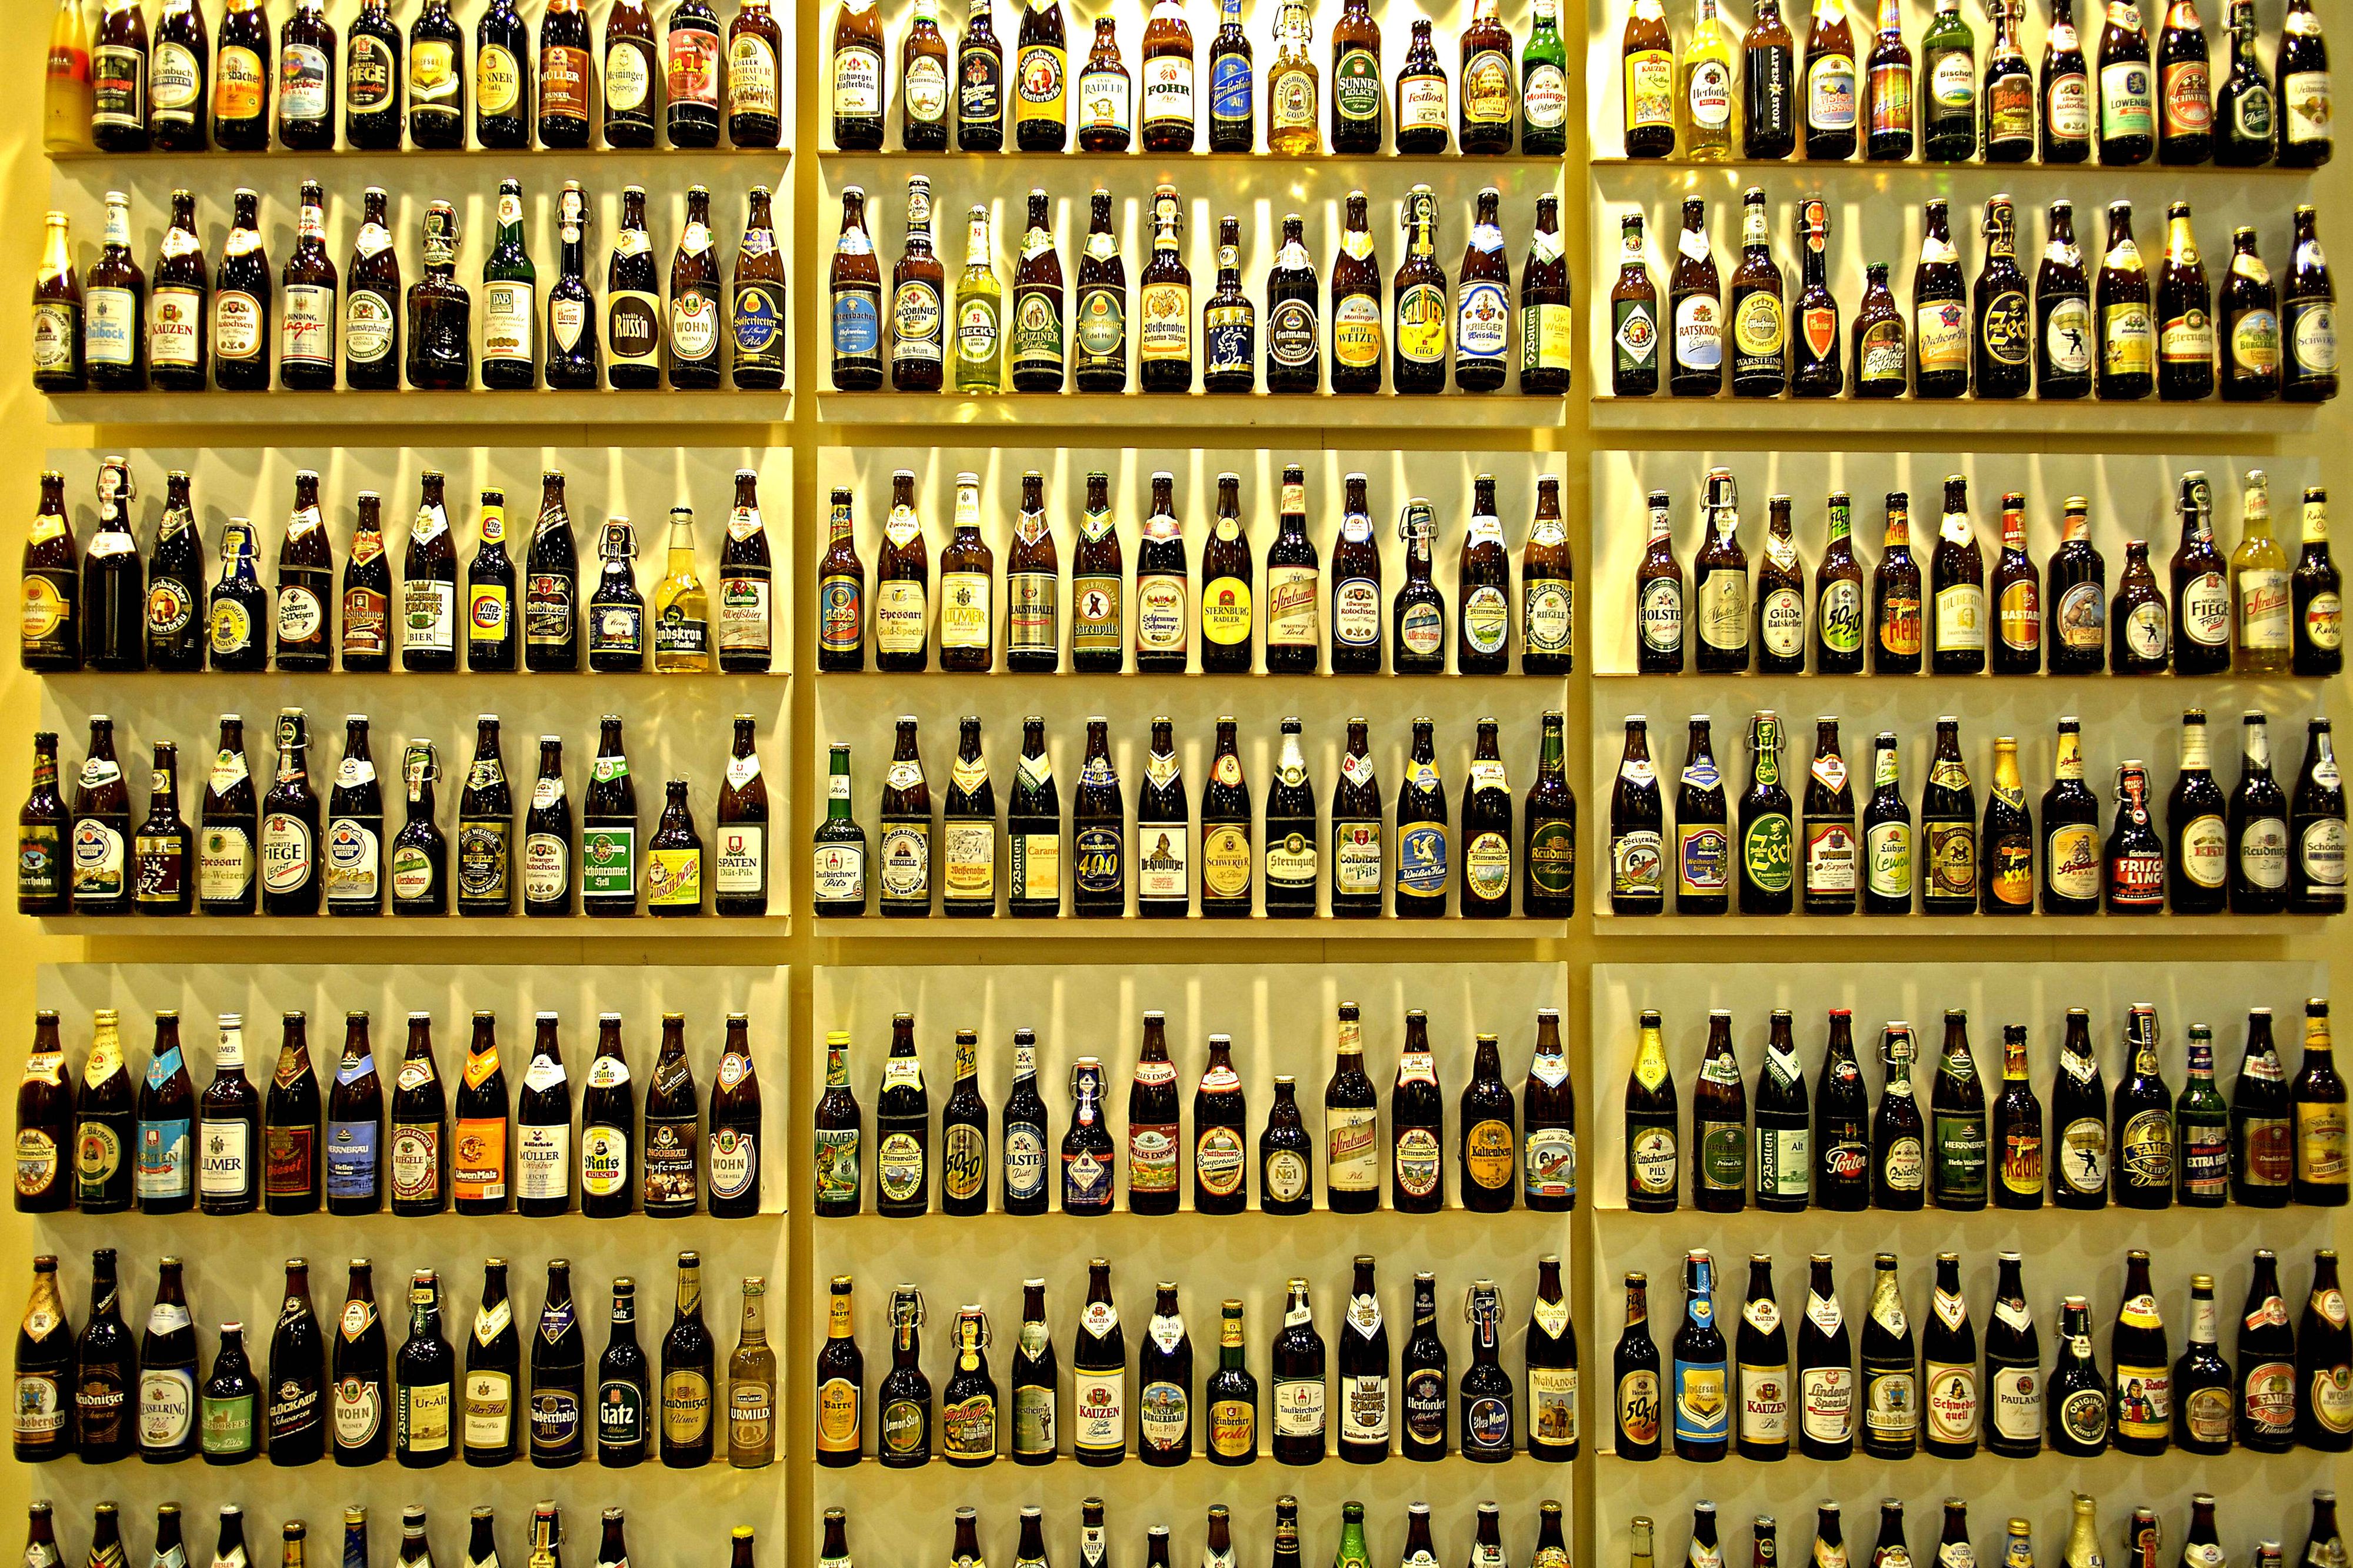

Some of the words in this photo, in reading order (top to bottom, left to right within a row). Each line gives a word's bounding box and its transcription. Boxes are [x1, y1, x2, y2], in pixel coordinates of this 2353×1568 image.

[1020, 49, 1061, 75] Alpirsbacher
[1771, 46, 1780, 83] ALPEN
[541, 71, 579, 83] MÜLLER
[608, 71, 642, 81] Meininger
[1339, 76, 1378, 91] SÜNNER
[1020, 85, 1061, 102] Klosterbräu
[1148, 84, 1189, 96] FOHR
[1345, 88, 1374, 98] KÖLSCH
[1692, 87, 1729, 99] Herforder
[1231, 96, 1243, 107] Alt
[1772, 98, 1780, 129] STOFF
[492, 294, 509, 305] DAB
[895, 307, 936, 318] JACOBINUS
[1407, 305, 1441, 324] RADLER
[152, 324, 192, 335] KAUZEN
[282, 316, 325, 339] Lager
[677, 322, 708, 333] WOHN
[959, 328, 995, 337] BECK'S
[1467, 323, 1503, 332] KRIEGER
[1679, 326, 1720, 336] RATSKRONE
[744, 336, 761, 345] Pils
[1014, 332, 1058, 343] KAPUZINER
[1277, 331, 1310, 339] Gutmann
[1339, 333, 1378, 343] WEIZEN
[1415, 346, 1434, 355] FIEGE
[1271, 587, 1317, 612] Stralsunder
[479, 603, 501, 613] Vita-
[1205, 606, 1249, 616] STERNBURG
[1341, 607, 1376, 615] Rotochsen
[2192, 601, 2229, 617] FIEGE
[476, 612, 499, 620] malz
[723, 609, 761, 620] Weißbier
[880, 608, 921, 620] Spessart
[1143, 615, 1178, 623] Schlemmer
[1537, 610, 1565, 619] RIEGELE
[1771, 609, 1800, 619] Gilde
[1768, 619, 1801, 628] Ratskeller
[409, 633, 432, 641] BIER
[879, 628, 923, 636] Gold-Specht
[1284, 628, 1304, 636] Bock
[214, 636, 237, 646] RADLER
[1358, 763, 1371, 777] Pils
[472, 829, 498, 844] WEISSE
[882, 829, 925, 849] COMMERZIENRAT
[264, 845, 301, 860] FIEGE
[1881, 844, 1905, 852] Lübzer
[464, 855, 493, 863] RIEGELE
[718, 858, 756, 867] SPATEN
[1079, 853, 1117, 875] 400
[1207, 856, 1249, 866] SCHWERTER
[1271, 855, 1315, 868] Sternquell
[1340, 853, 1380, 864] Colbitzer
[268, 862, 292, 879] LEICHT
[1825, 863, 1848, 871] Export
[720, 869, 752, 877] Diät-Pils
[2004, 870, 2030, 885] XXL
[595, 877, 609, 886] Hell
[824, 879, 846, 888] Pils
[595, 1069, 615, 1079] Rats
[818, 1132, 854, 1142] ULMER
[1792, 1142, 1804, 1151] Alt
[138, 1152, 178, 1163] SPATEN
[519, 1150, 559, 1161] MÜLLER
[1151, 1147, 1175, 1159] EXPORT
[1471, 1146, 1511, 1159] Kaltenberg
[395, 1156, 424, 1164] RIEGELE
[585, 1156, 619, 1169] Rats
[713, 1158, 744, 1169] WOHN
[946, 1151, 962, 1175] 50
[961, 1156, 980, 1175] 50
[1827, 1150, 1867, 1174] Porter
[2188, 1156, 2213, 1167] EXTRA
[1013, 1168, 1031, 1179] Diät
[1346, 1172, 1364, 1180] Pils
[1649, 1167, 1665, 1176] PILS
[1399, 1173, 1422, 1194] HELLER
[1423, 1173, 1437, 1192] BOCK
[1292, 1312, 1307, 1320] Hell
[415, 1395, 447, 1408] Ur-Alt
[824, 1400, 852, 1410] Barre
[1408, 1397, 1445, 1410] Herforder
[1747, 1400, 1787, 1413] KAUZEN
[1814, 1396, 1849, 1407] Spezial
[2071, 1397, 2105, 1414] ORIGINAL
[336, 1407, 370, 1419] WOHN
[601, 1402, 634, 1424] Gatz
[1079, 1406, 1119, 1418] KAUZEN
[1152, 1407, 1175, 1415] UNSER
[1280, 1404, 1322, 1413] Taufkirchner
[669, 1413, 699, 1423] Pilsner
[1294, 1413, 1311, 1423] Hell
[1945, 1410, 1968, 1420] quell
[1474, 1416, 1488, 1429] Blue
[1489, 1413, 1505, 1424] Moon
[539, 1423, 559, 1435] Alt
[1149, 1423, 1162, 1432] Das
[1214, 1424, 1251, 1440] Gold
[1084, 1542, 1102, 1550] STIER
